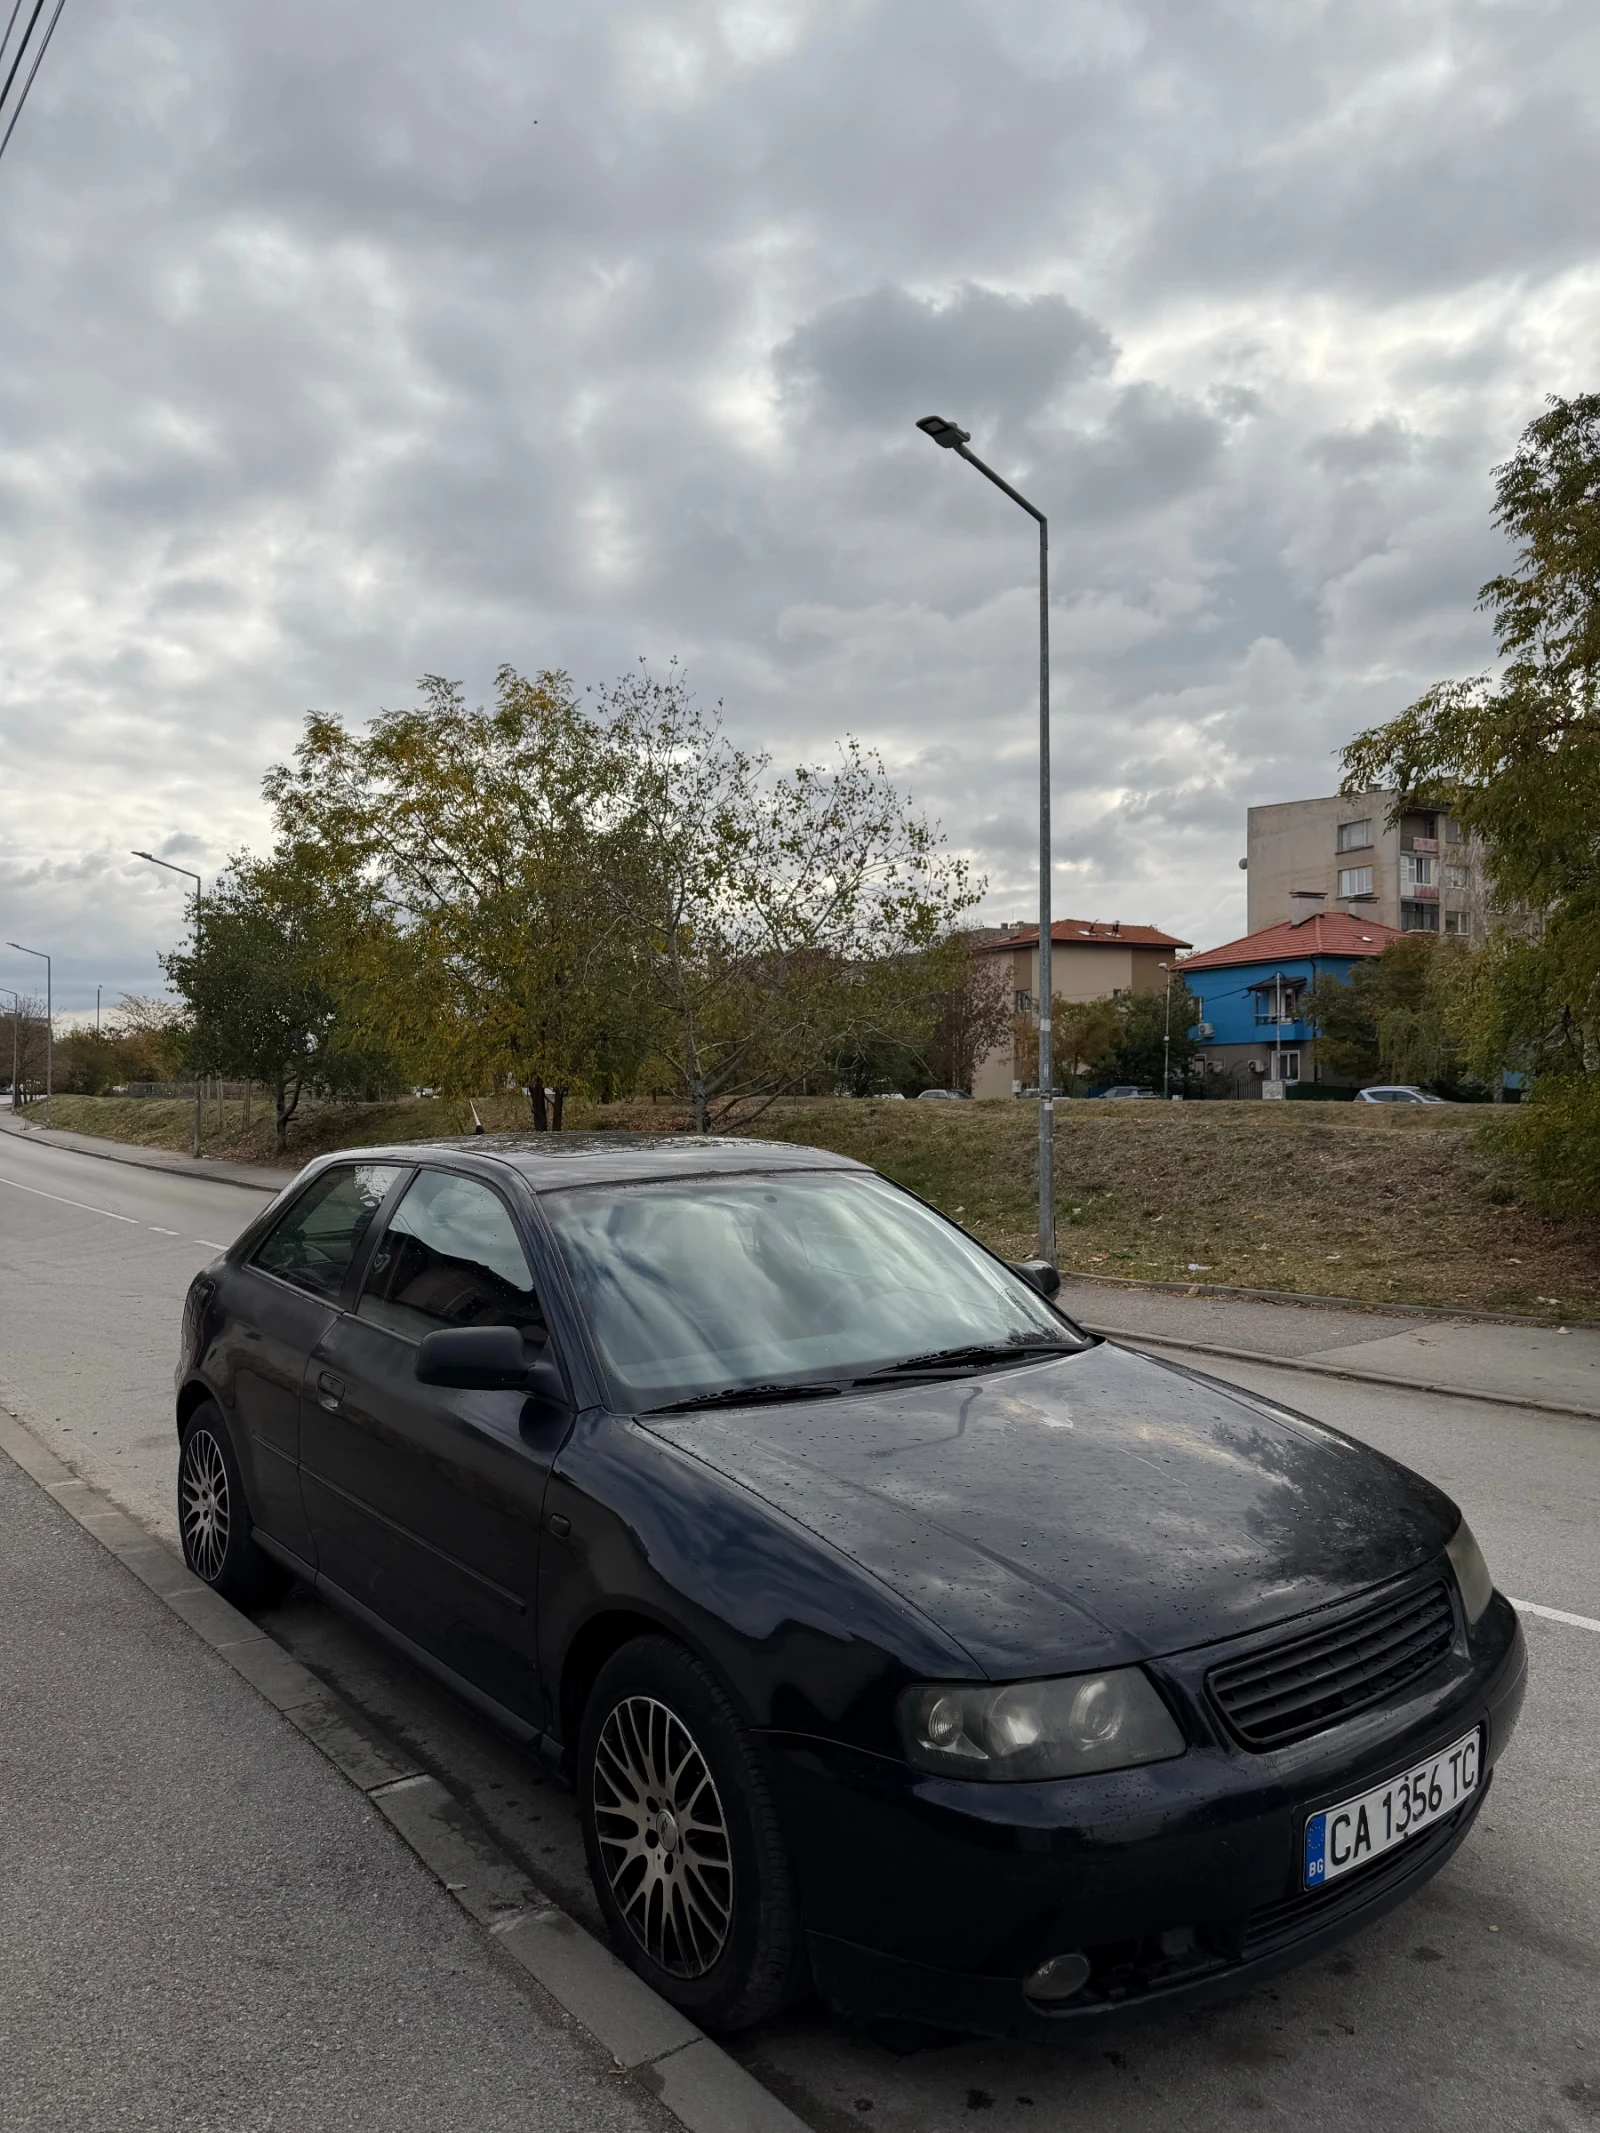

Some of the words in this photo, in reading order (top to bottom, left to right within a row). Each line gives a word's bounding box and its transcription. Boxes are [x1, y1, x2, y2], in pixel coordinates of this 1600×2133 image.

[1331, 1805, 1371, 1866] CA
[1383, 1764, 1442, 1840] 1356
[1449, 1742, 1475, 1799] TC
[1309, 1858, 1324, 1877] BG
